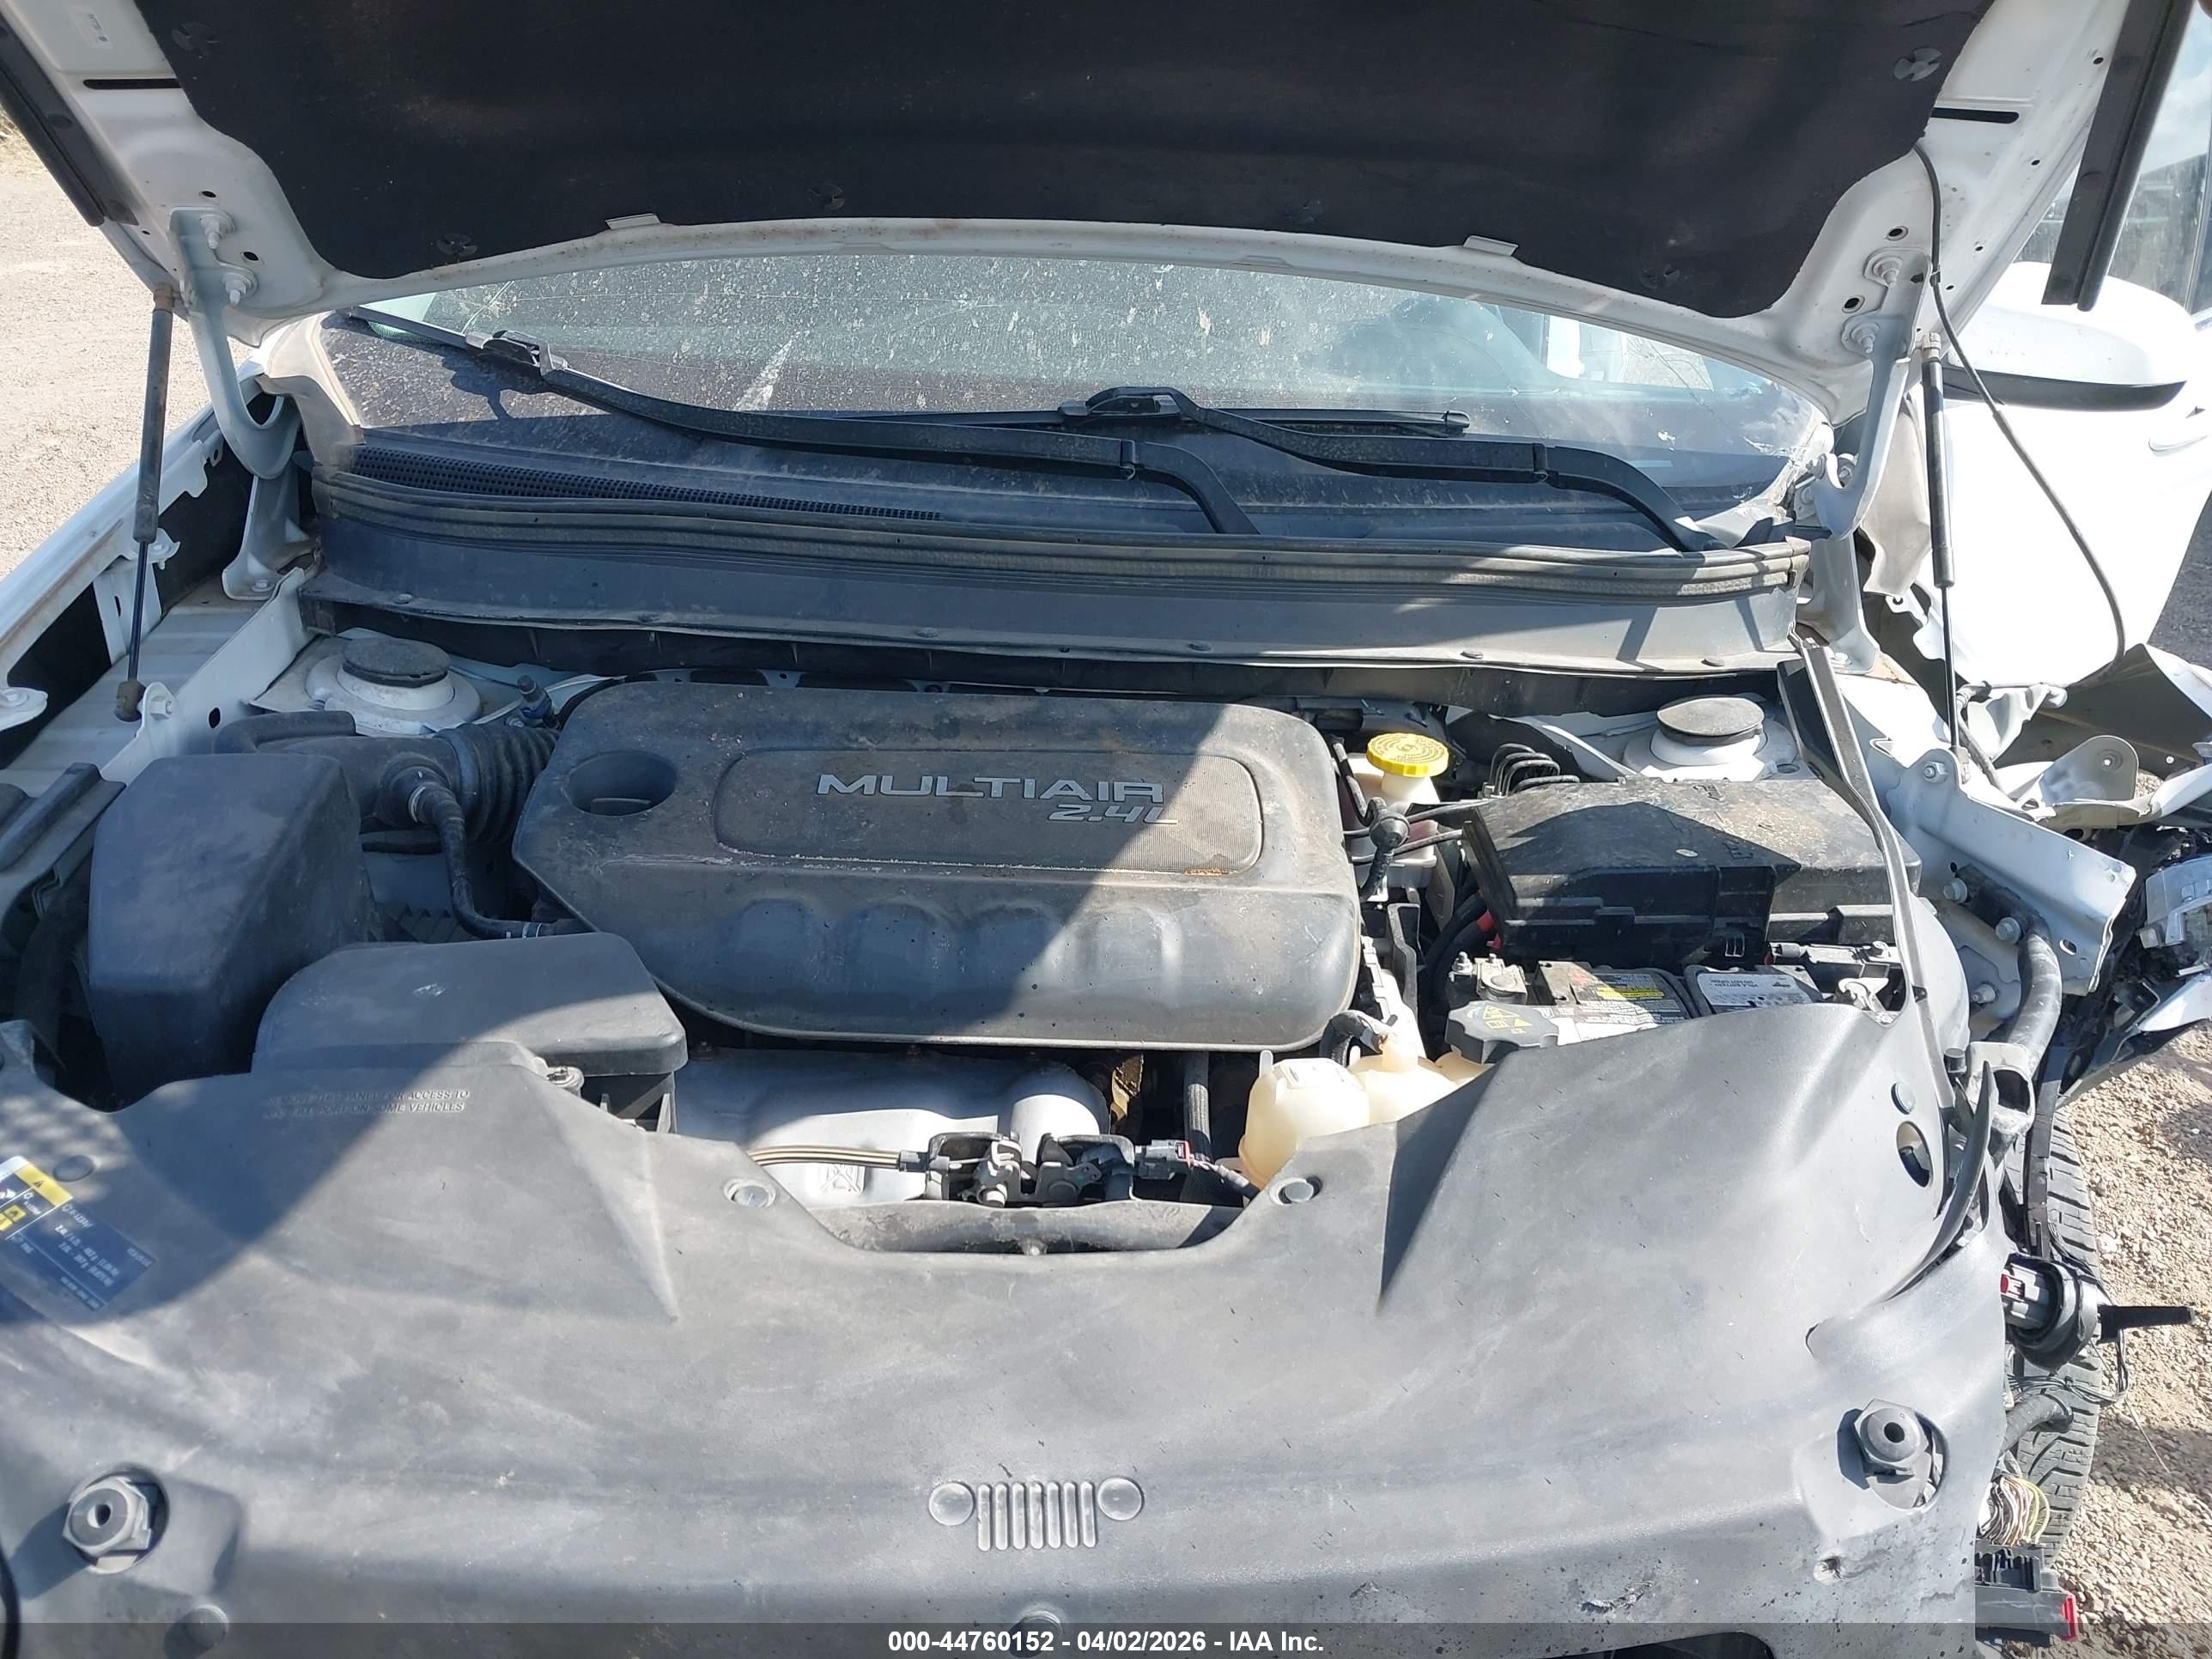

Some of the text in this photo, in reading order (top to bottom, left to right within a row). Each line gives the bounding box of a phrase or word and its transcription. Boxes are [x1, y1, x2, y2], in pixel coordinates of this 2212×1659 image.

[817, 774, 1164, 804] MULTIAIR
[1048, 804, 1179, 824] 2.4L
[383, 1091, 404, 1100] FOR
[408, 1091, 452, 1099] ACCESS
[454, 1090, 470, 1099] TO
[374, 1104, 405, 1114] SOME
[408, 1102, 465, 1113] VEHICLES
